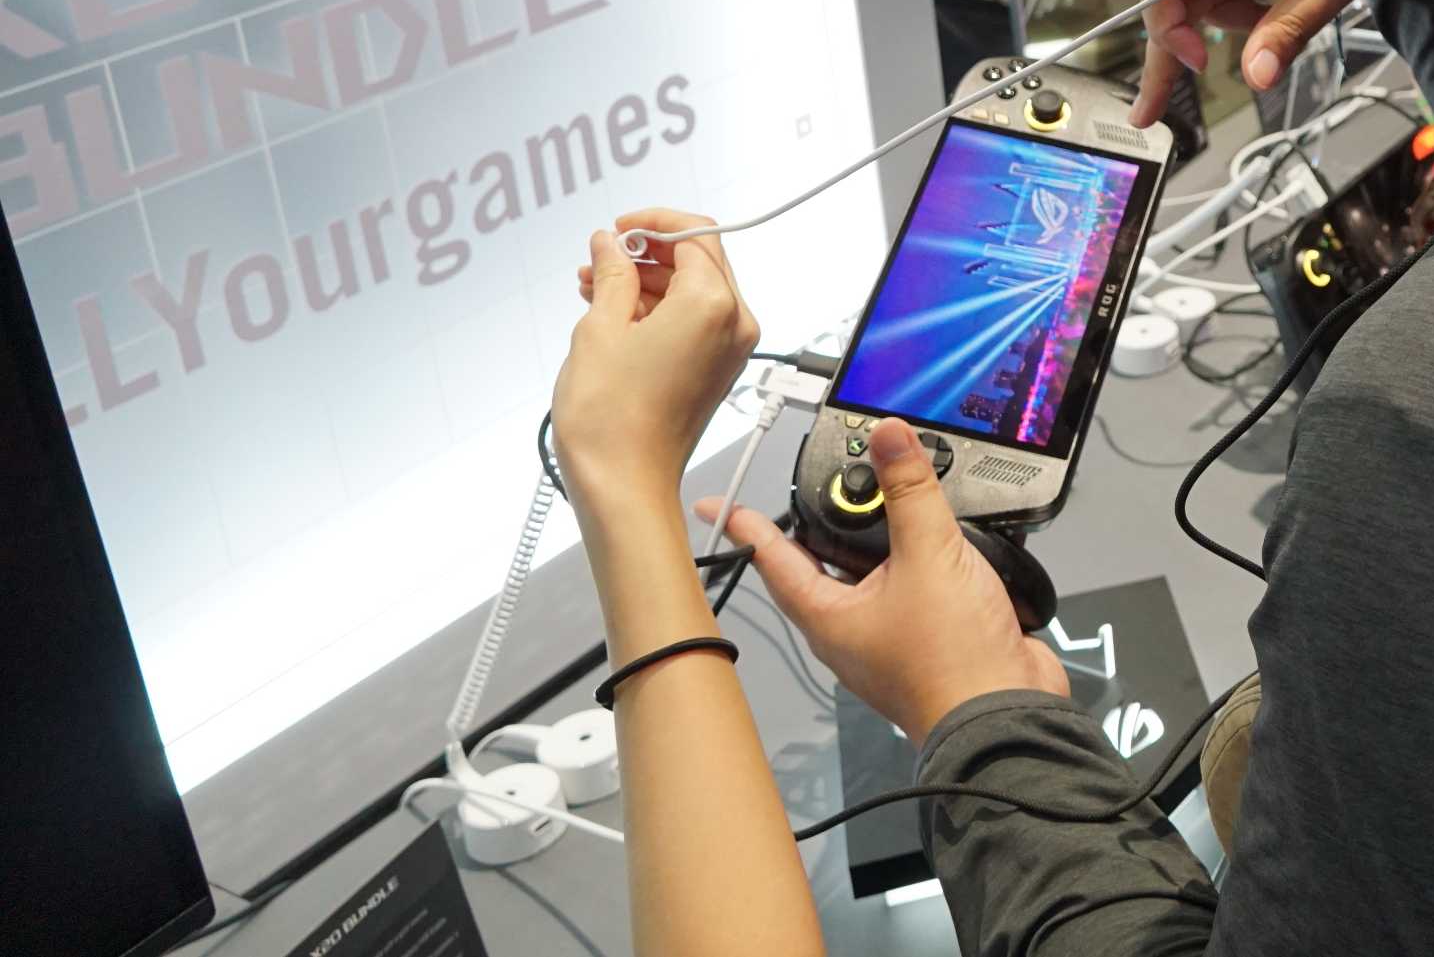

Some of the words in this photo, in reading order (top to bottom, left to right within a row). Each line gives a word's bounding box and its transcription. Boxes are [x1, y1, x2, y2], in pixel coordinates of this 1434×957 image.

[66, 72, 698, 428] LYourgames
[1097, 283, 1117, 317] ROG
[342, 875, 399, 934] BUNDLE
